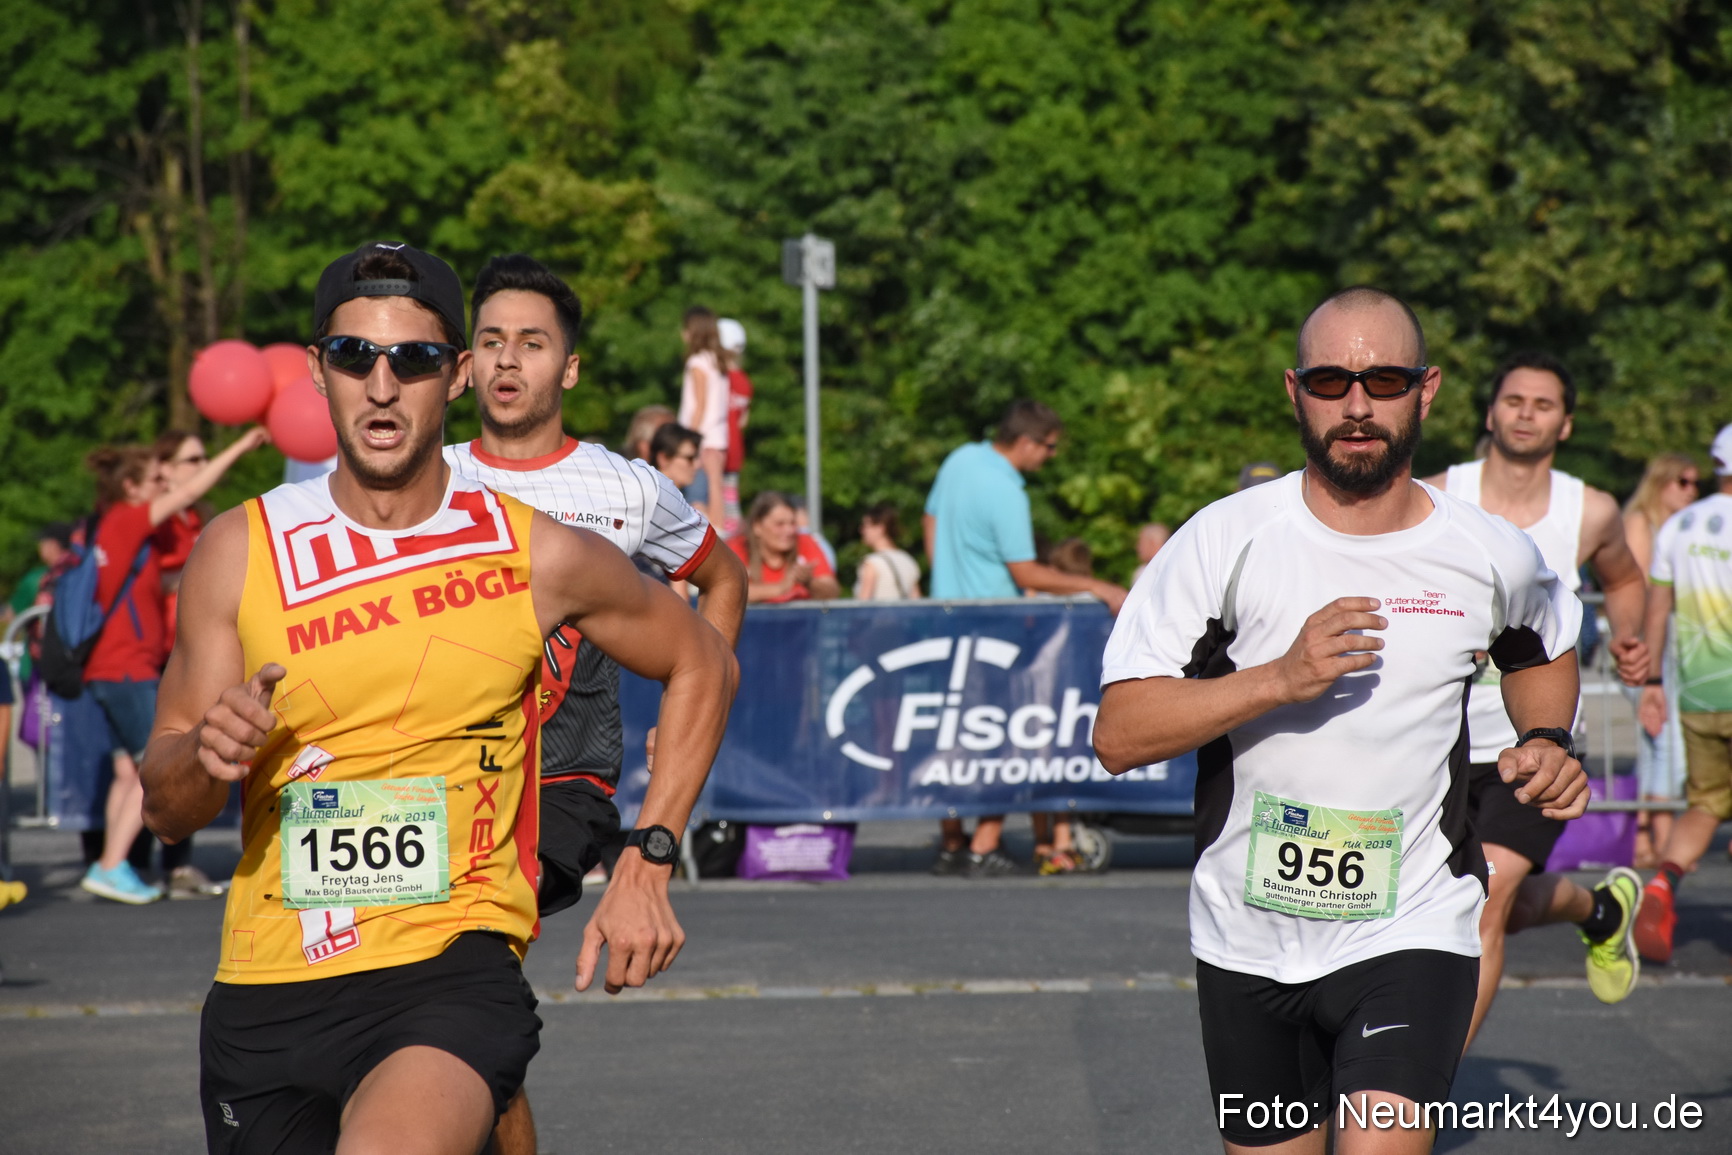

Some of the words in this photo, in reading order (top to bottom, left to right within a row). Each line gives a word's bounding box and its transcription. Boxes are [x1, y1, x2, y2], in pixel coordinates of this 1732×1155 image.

[542, 511, 611, 527] EUMARKT
[1385, 597, 1440, 607] guttenberger
[1422, 590, 1446, 599] Team
[286, 595, 401, 656] MAX
[412, 567, 530, 618] BÖGL
[1398, 606, 1465, 617] lichttechnik
[892, 687, 1100, 751] Fisch
[302, 805, 365, 819] firmenlauf
[405, 811, 435, 823] 2019
[1272, 818, 1331, 840] firmenlauf
[300, 824, 425, 873] 1566
[1365, 839, 1392, 849] 2019
[1277, 841, 1365, 889] 956
[321, 874, 369, 888] Freytag
[373, 873, 404, 884] Jens
[304, 888, 321, 897] Max
[323, 888, 343, 898] Bögl
[345, 886, 394, 896] Bauservice
[395, 884, 423, 893] GmbH
[1263, 878, 1316, 898] Baumann
[1319, 890, 1377, 902] Christoph
[1265, 892, 1314, 908] guttenberger
[1316, 900, 1345, 910] partner
